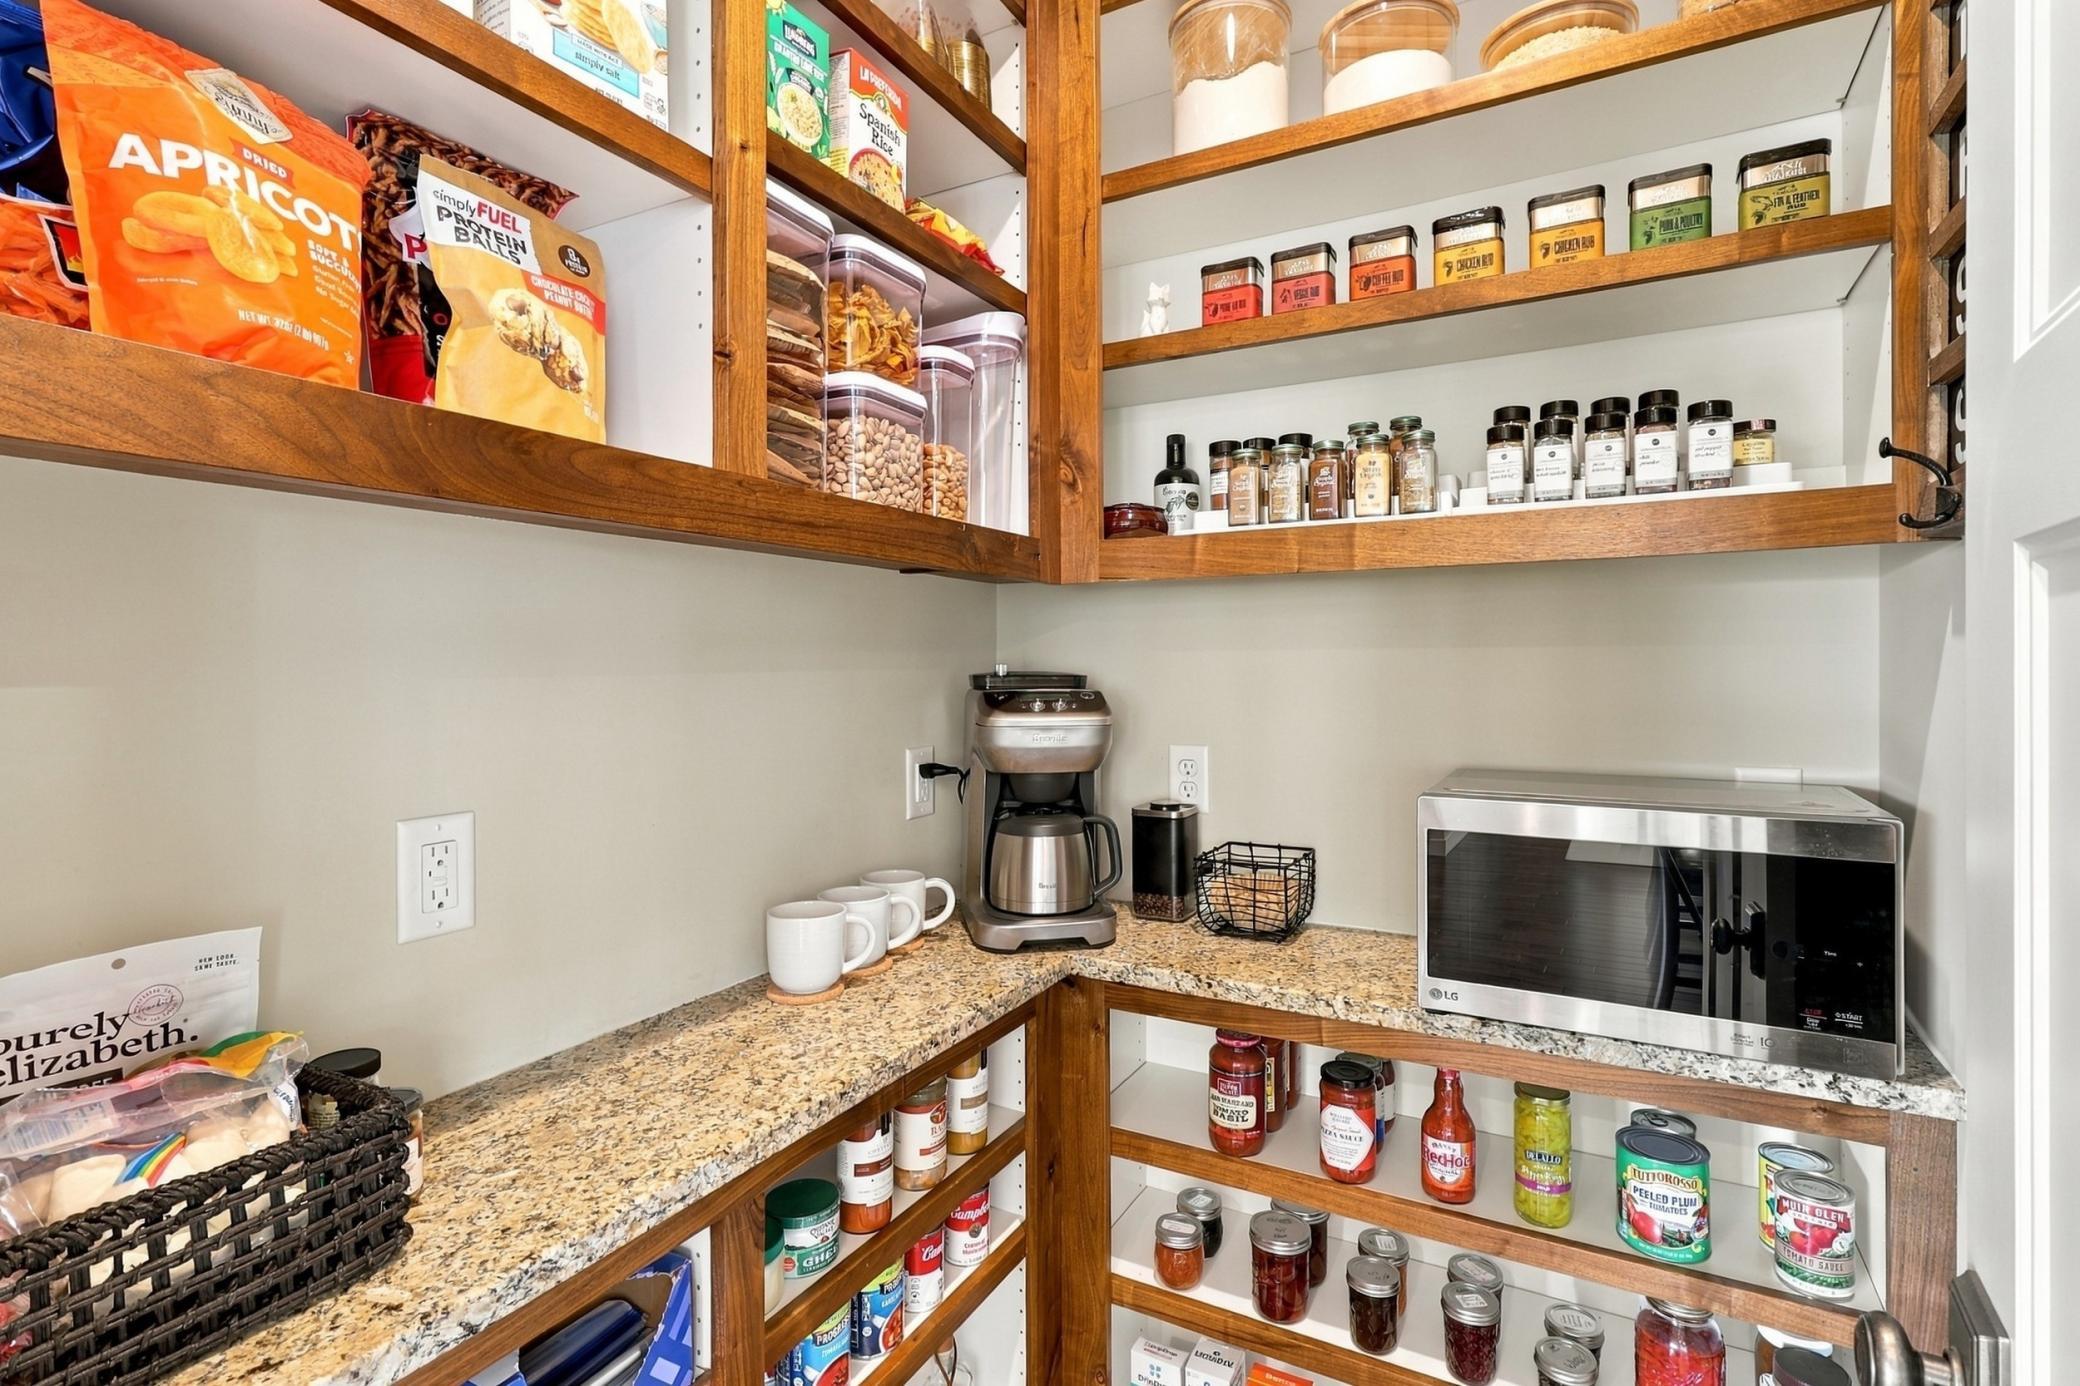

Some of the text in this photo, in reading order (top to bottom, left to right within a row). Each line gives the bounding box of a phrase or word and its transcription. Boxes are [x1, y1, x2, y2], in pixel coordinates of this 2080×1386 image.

[859, 102, 901, 147] Spanish
[871, 127, 893, 157] Rice
[242, 147, 288, 178] DRIED
[108, 132, 361, 253] APRICOT
[436, 205, 528, 255] PROTEIN
[454, 226, 521, 265] BALLS
[1443, 990, 1459, 1002] LG
[1841, 1013, 1863, 1022] START
[0, 1023, 199, 1088] lizabeth.
[1212, 1102, 1249, 1116] TOMATO
[1213, 1109, 1249, 1123] BASIL
[1631, 1166, 1699, 1190] TUTTOROSSO
[1633, 1185, 1698, 1208] PEELED PLUM
[1649, 1202, 1689, 1216] TOMATOES
[1782, 1198, 1845, 1223] MUIR GLEN
[1782, 1246, 1846, 1272] TOMATO SAUCE
